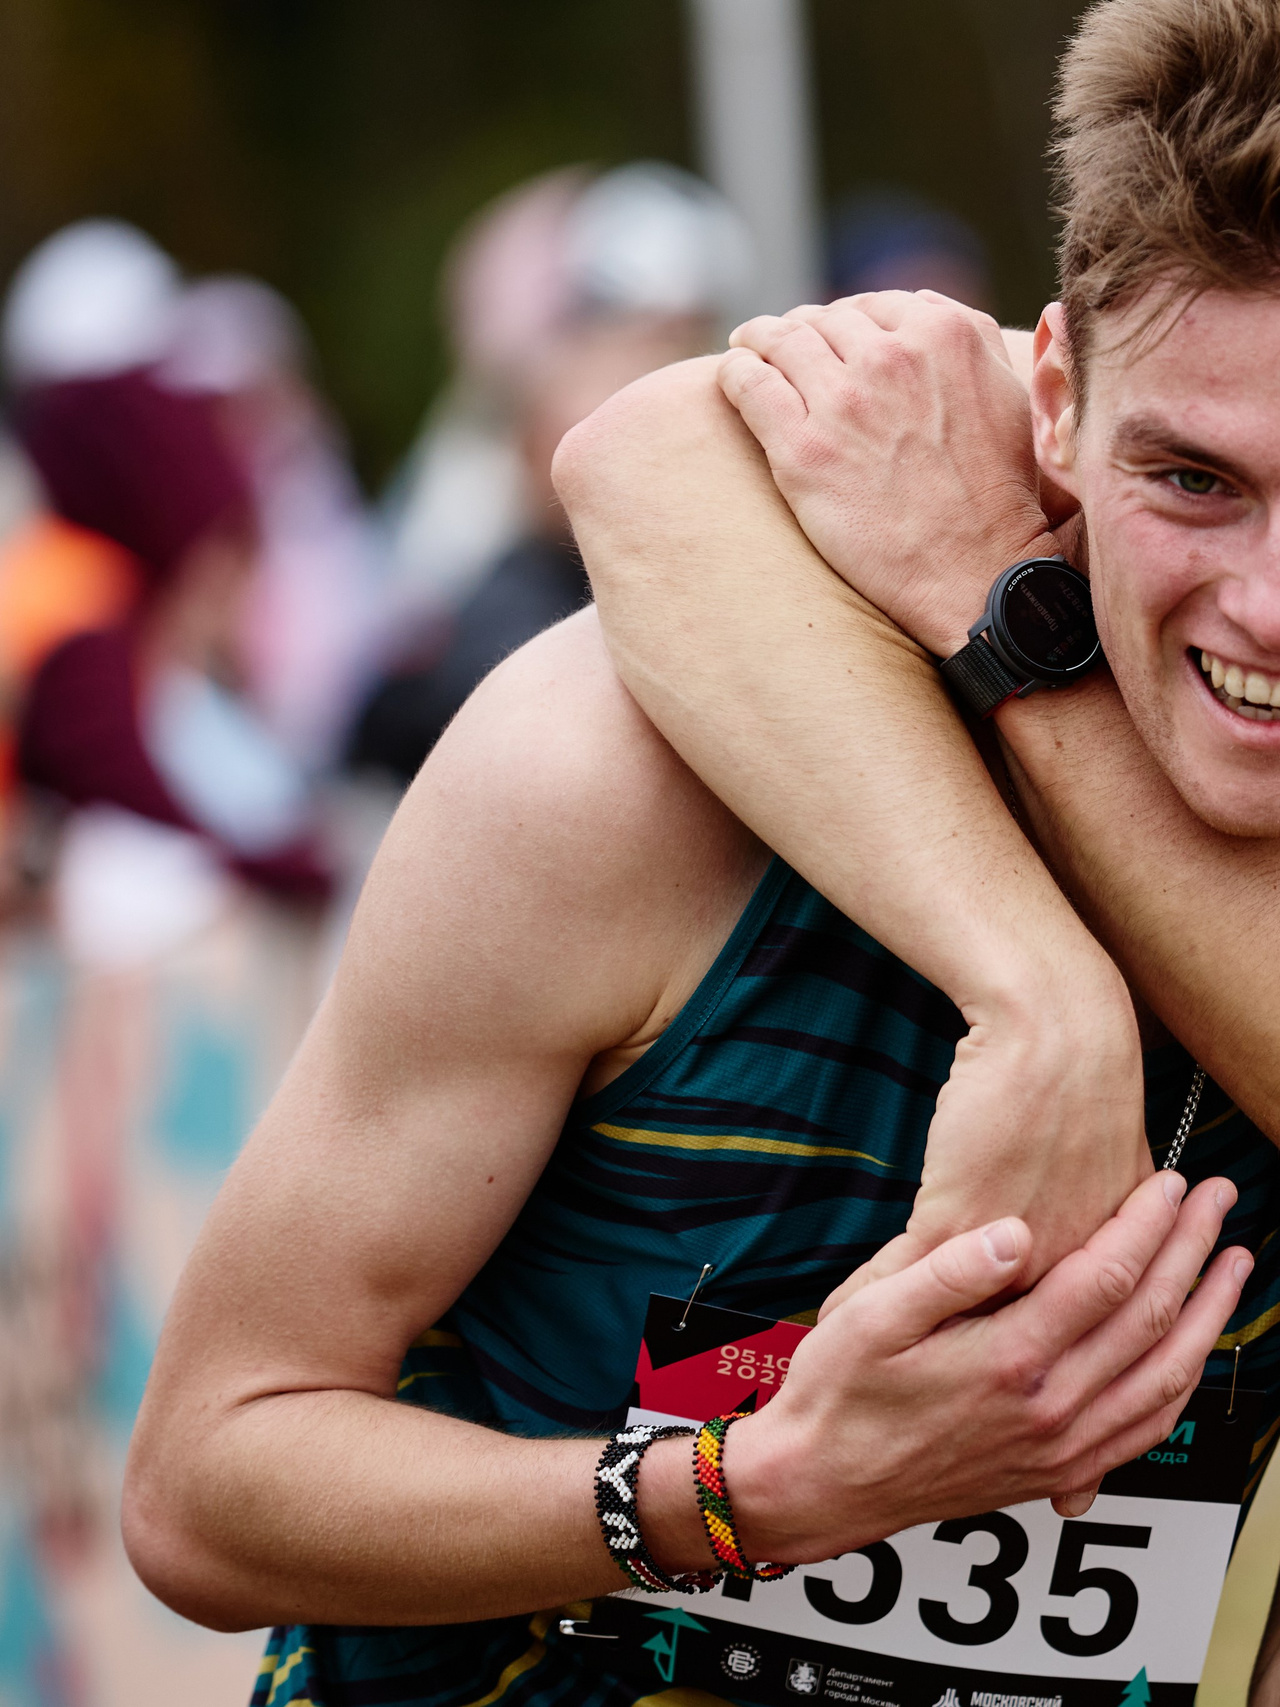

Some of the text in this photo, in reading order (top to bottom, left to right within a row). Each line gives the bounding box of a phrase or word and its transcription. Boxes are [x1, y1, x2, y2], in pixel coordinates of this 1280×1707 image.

[1008, 567, 1035, 592] COROS
[716, 1360, 788, 1387] 202
[1138, 1450, 1189, 1465] ода
[721, 1509, 1154, 1657] 535
[825, 1679, 861, 1693] спорта
[827, 1667, 895, 1689] Департамент
[824, 1689, 861, 1703] города
